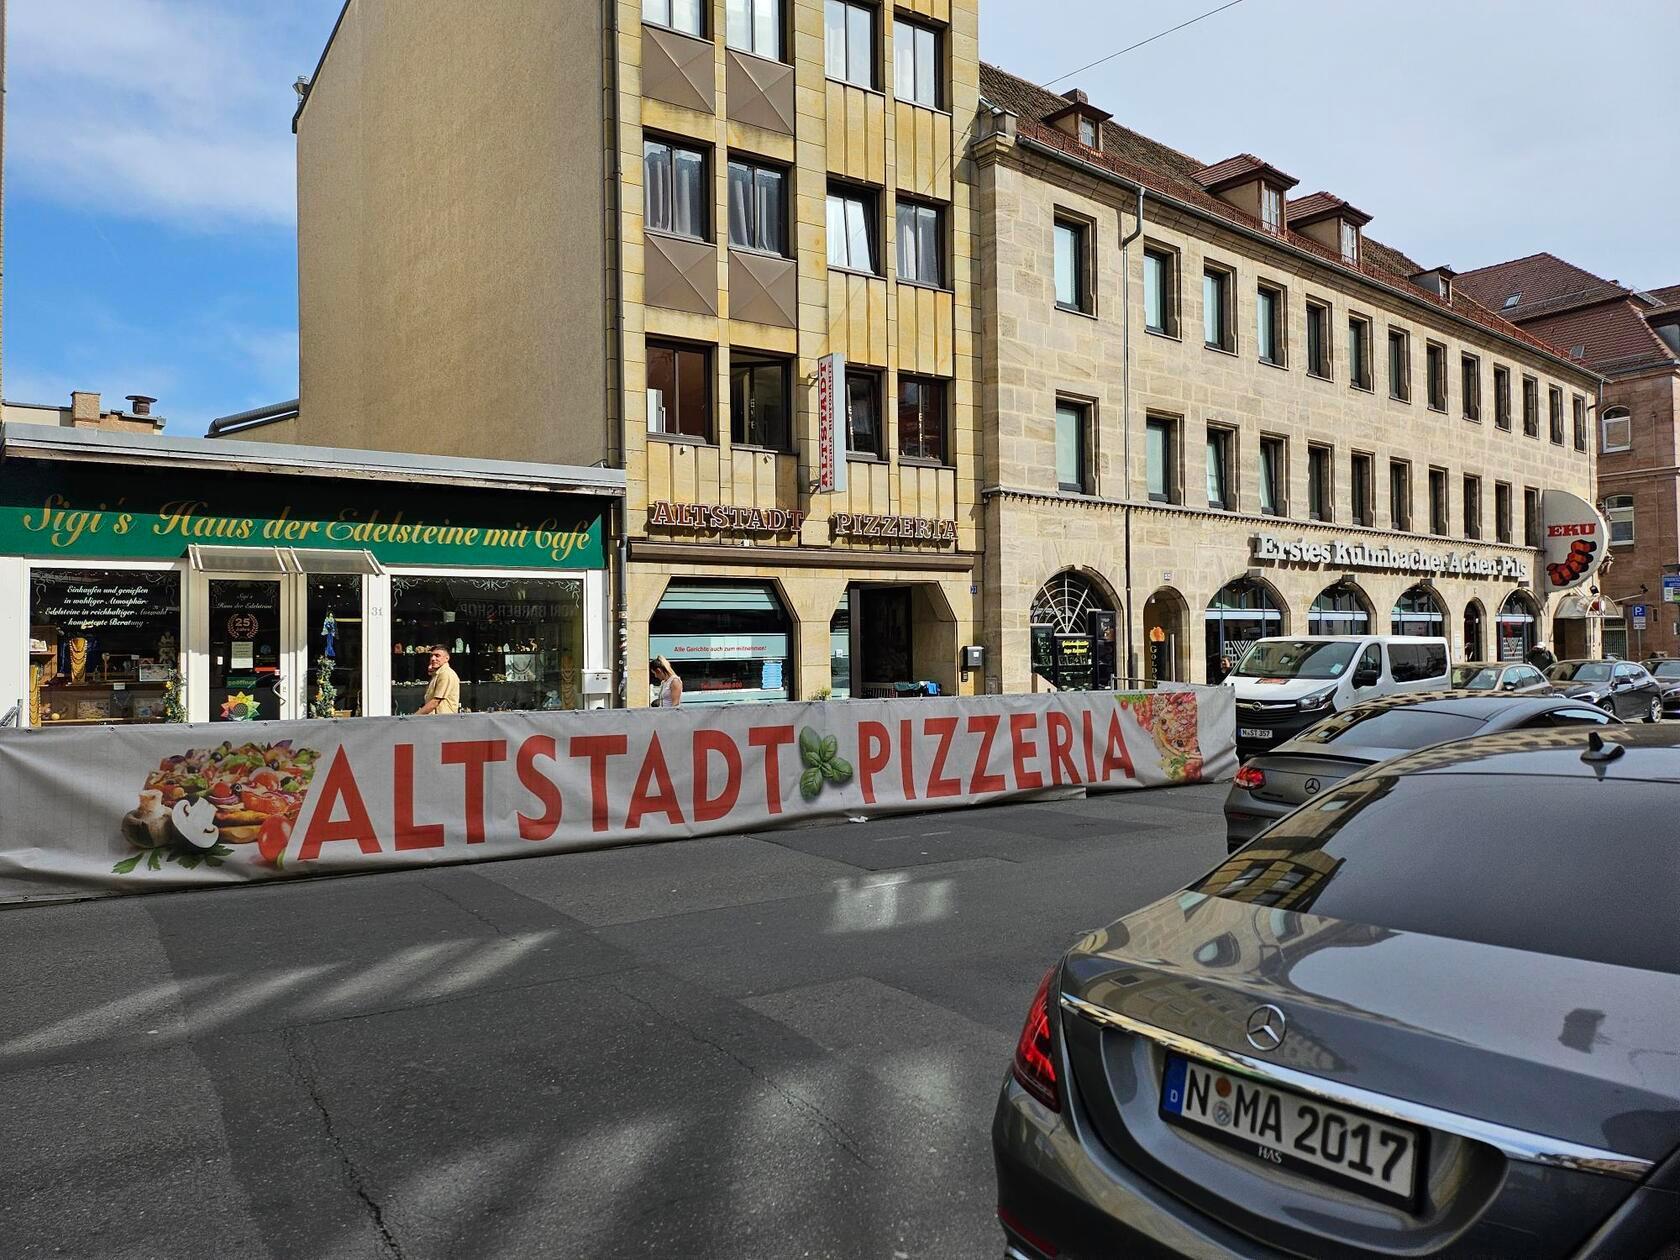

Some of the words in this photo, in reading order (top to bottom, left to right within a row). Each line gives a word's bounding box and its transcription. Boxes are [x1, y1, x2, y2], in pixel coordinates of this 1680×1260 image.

[820, 362, 828, 488] ALTSTADT
[153, 500, 258, 538] Haus
[263, 506, 321, 540] der
[325, 507, 484, 547] Edelsteine
[482, 521, 530, 548] mit
[651, 500, 804, 532] ALTSTADT
[835, 512, 959, 541] PIZZERIA
[1547, 523, 1597, 537] EKU
[1255, 533, 1332, 564] Erstes
[1334, 540, 1449, 572] Kulmbacher
[67, 585, 102, 596] Einkaufen
[103, 586, 116, 594] und
[73, 598, 104, 608] wohliger
[45, 607, 80, 616] Edelsteine
[81, 608, 89, 616] in
[90, 608, 135, 618] reichhaltiger
[371, 606, 383, 616] 31
[1635, 606, 1642, 616] P
[109, 618, 144, 628] Beratung
[235, 618, 251, 627] 25
[297, 724, 795, 861] ALTSTADT
[857, 707, 1136, 804] PIZZERIA
[1171, 1089, 1178, 1102] D
[1186, 1069, 1211, 1116] N
[1233, 1084, 1283, 1143] MA
[1294, 1105, 1409, 1183] 2017
